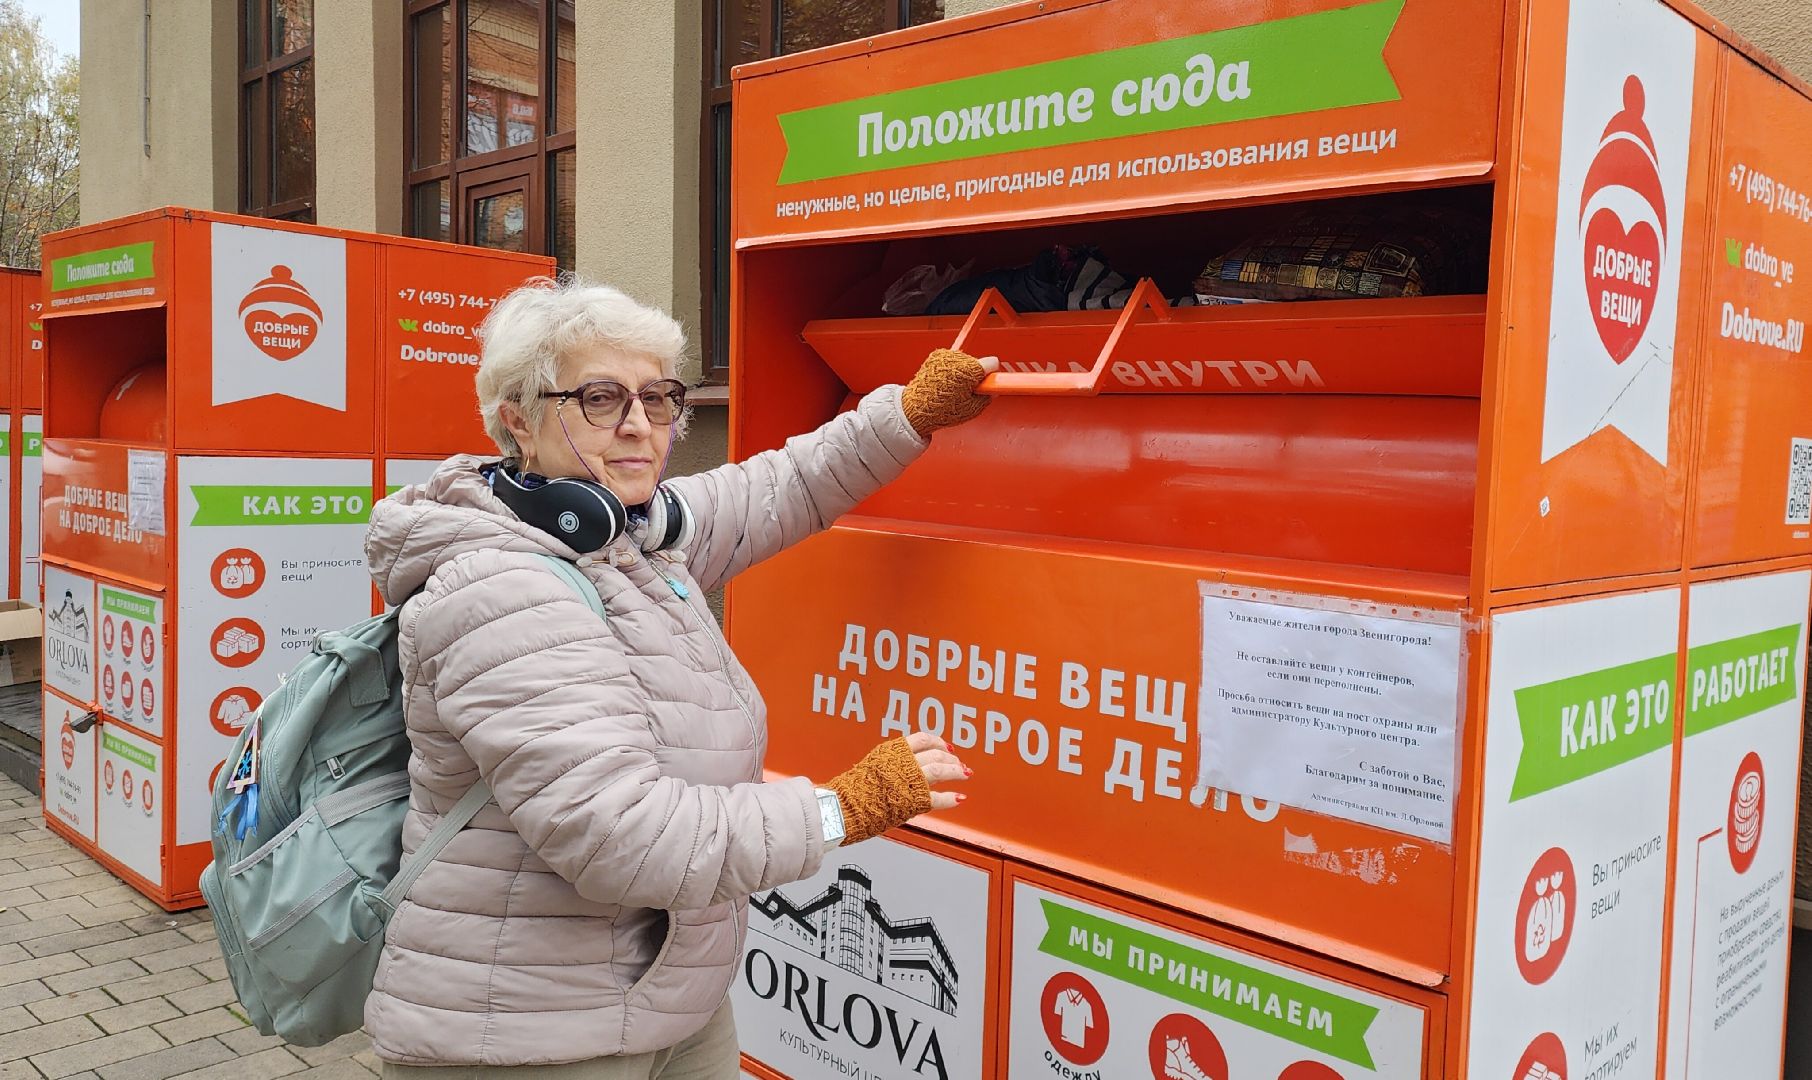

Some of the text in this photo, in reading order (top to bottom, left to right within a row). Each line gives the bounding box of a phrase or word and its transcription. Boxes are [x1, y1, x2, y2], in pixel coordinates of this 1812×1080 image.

[857, 53, 1251, 157] Положите сюда
[776, 127, 1397, 219] ненужные, но целые, пригодные для использования вещи
[1730, 163, 1812, 223] +7 (495) 744-76-
[67, 254, 134, 282] Положите сюда
[1593, 245, 1653, 288] ДОБРЫЕ
[1745, 242, 1794, 288] dobro_ve
[398, 288, 497, 309] +7 (495) 744-7
[1601, 290, 1642, 327] ВЕЩИ
[253, 321, 309, 337] ДОБРЫЕ
[262, 336, 301, 350] ВЕЩИ
[1111, 359, 1326, 387] ВНУТРИ
[64, 485, 127, 518] ДОБРЫЕ ВЕЩ
[243, 496, 363, 515] КАК ЭТО
[59, 509, 71, 528] НА
[73, 512, 111, 536] ДОБРОЕ
[281, 559, 362, 569] Вы приносите
[281, 573, 312, 582] вещи
[281, 627, 318, 636] Мы их
[281, 641, 313, 653] сорти
[1229, 611, 1432, 646] Уважаемые жители города Звенигорода!
[49, 636, 89, 673] ORLOVA
[1237, 651, 1415, 686] Не оставляйте вещи у контейнеров,
[838, 623, 1187, 743] ДОБРЫЕ ВЕЩ
[1267, 671, 1381, 696] если они переполнены.
[1218, 688, 1437, 734] Просьба относить вещи на пост охраны или
[1560, 647, 1788, 758] КАК ЭТО РАБОТАЕТ
[812, 673, 866, 724] НА
[881, 689, 1083, 776] ДОБРОЕ
[1231, 706, 1420, 747] администратору Культурного центра.
[1305, 764, 1445, 802] Благодарим за понимание.
[1359, 761, 1367, 771] С
[1369, 763, 1409, 780] заботой
[1423, 775, 1445, 788] Вас,
[1592, 834, 1662, 887] Вы приносите
[1591, 889, 1620, 920] вещи
[1068, 926, 1333, 1037] МЫ ПРИНИМАЕМ
[745, 948, 949, 1080] ORLOVA
[779, 1029, 861, 1078] КУЛЬТУРНЫЙ
[1584, 1022, 1619, 1062] Мы их
[1585, 1037, 1637, 1080] ортируем
